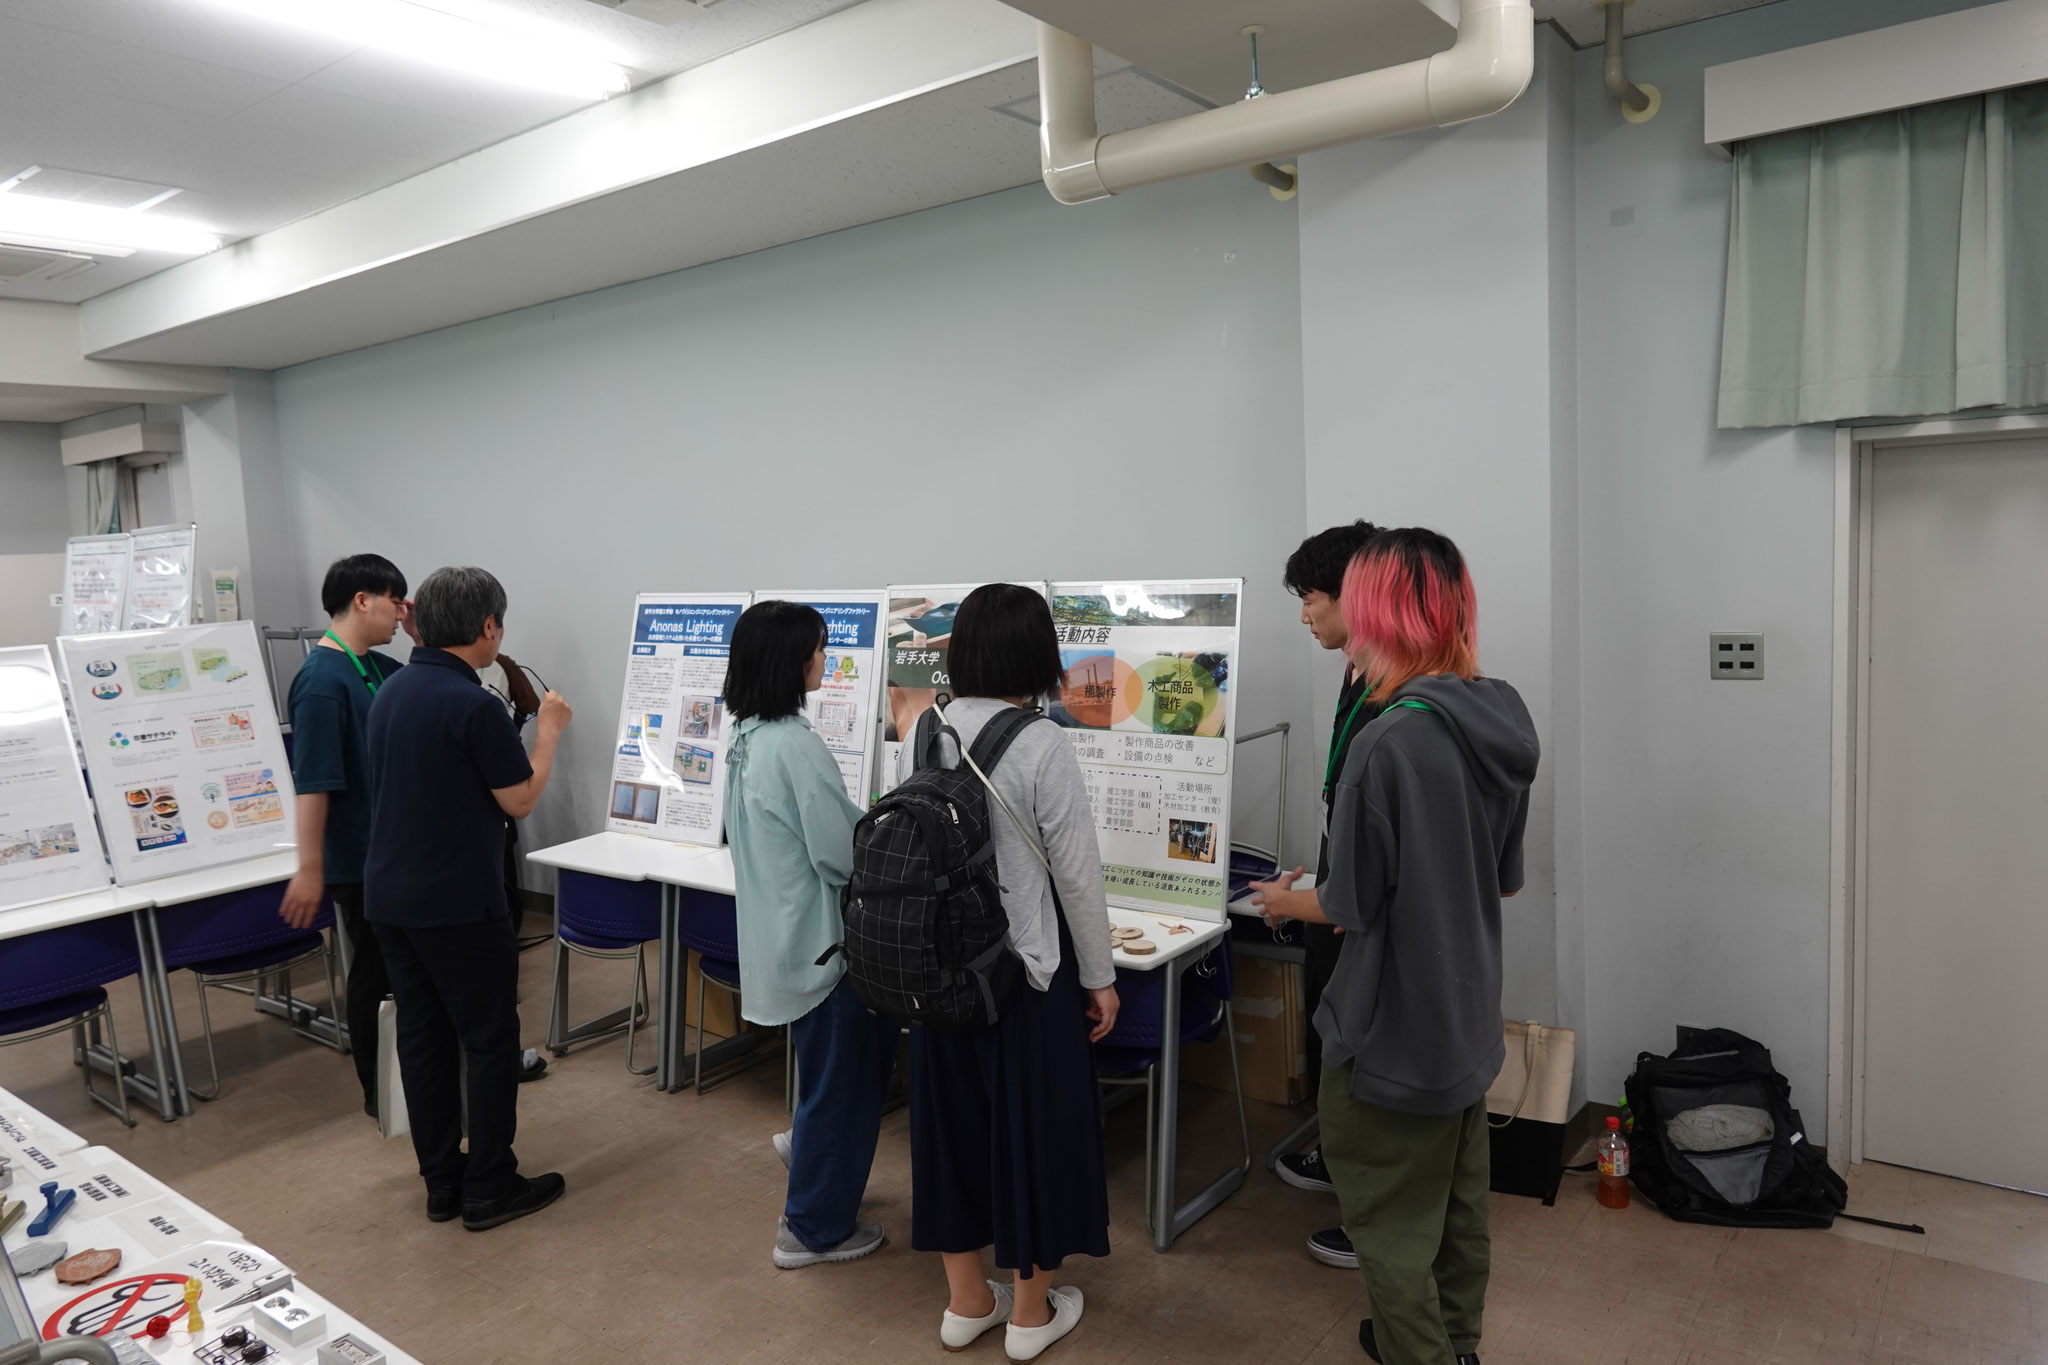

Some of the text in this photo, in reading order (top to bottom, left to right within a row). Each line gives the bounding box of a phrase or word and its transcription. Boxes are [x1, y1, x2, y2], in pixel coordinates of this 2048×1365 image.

[649, 619, 724, 635] Anonas Lighting
[1056, 627, 1111, 643] 活動内容
[895, 651, 940, 665] 岩手大学
[1148, 680, 1193, 694] 木工商品
[1158, 697, 1181, 710] 製作
[1073, 746, 1105, 759] の調査
[1195, 756, 1215, 767] など
[1177, 781, 1213, 794] 活動場所
[1102, 875, 1222, 897] を培い成長している活気あふれるカンパ
[188, 1257, 241, 1290] 触らないで
